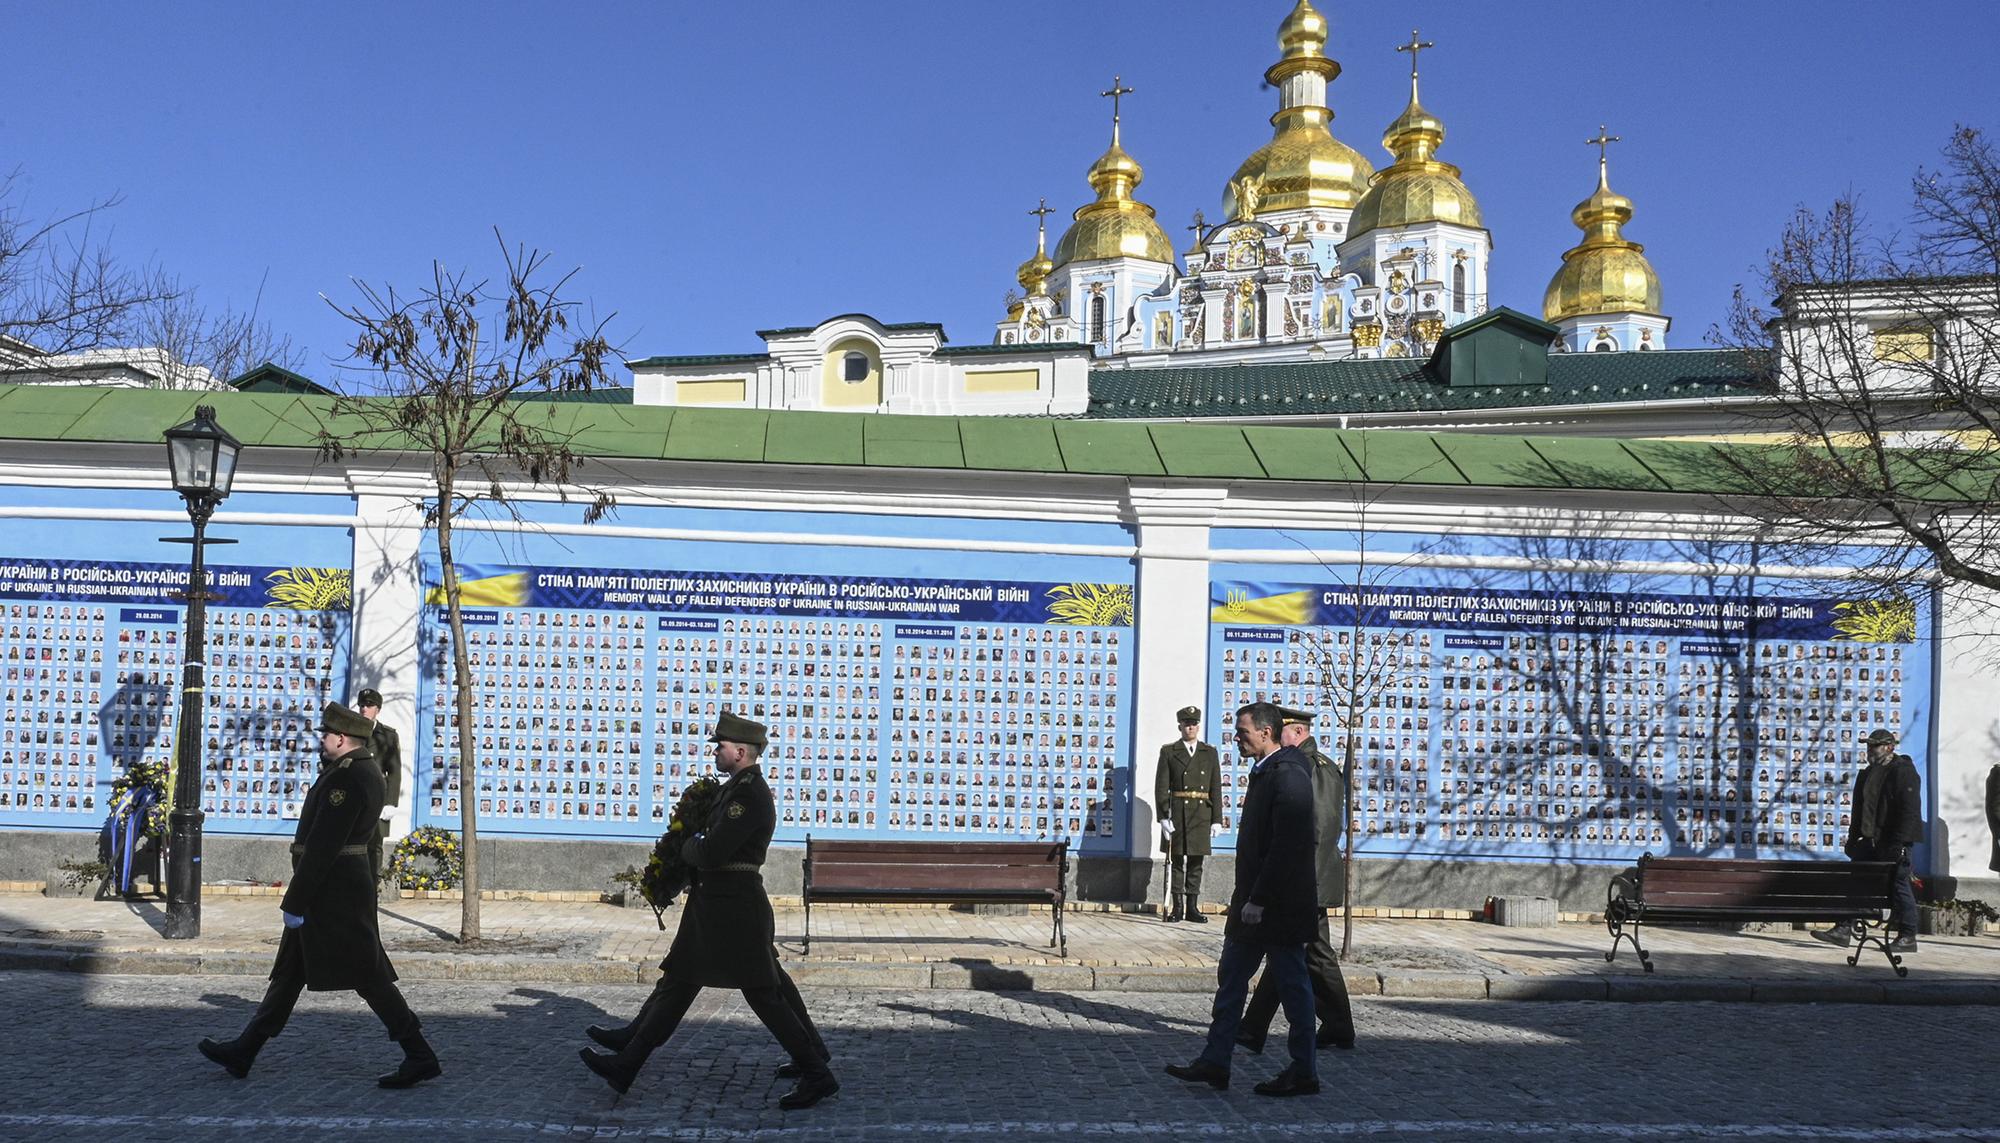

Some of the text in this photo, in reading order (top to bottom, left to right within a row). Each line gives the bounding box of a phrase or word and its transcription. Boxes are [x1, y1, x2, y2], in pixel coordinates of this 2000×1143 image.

[51, 567, 59, 580] В
[219, 572, 251, 587] ВІЙНІ
[1, 582, 12, 591] OF
[15, 582, 53, 593] UKRAINE
[56, 584, 65, 593] IN
[67, 584, 158, 597] RUSSIAN-UKRAINIAN
[538, 574, 1030, 602] СТІНА ПАМ'ЯТІ ПОЛЕГЛИХ ЗАХИСНИКІВ УКРАЇНИ В РОСІЙСЬКО-УКРАЇНСЬКІЙ ВІЙНІ
[604, 592, 960, 613] MEMORY WALL OF FALLEN DEFENDERS OF UKRAINE IN RUSSIAN-UKRAINIAN WAR
[1323, 592, 1813, 619] СТІНА ПАМ'ЯТІ ПОЛЕГЛИХ ЗАХИСНИКІВ УКРАЇНИ В РОСІЙСЬКО-УКРАЇНСЬКІЙ ВІЙНІ
[1389, 610, 1744, 630] MEMORY WALL OF FALLEN DEFENDERS OF UKRAINE IN RUSSIAN-UKRAINIAN WAR
